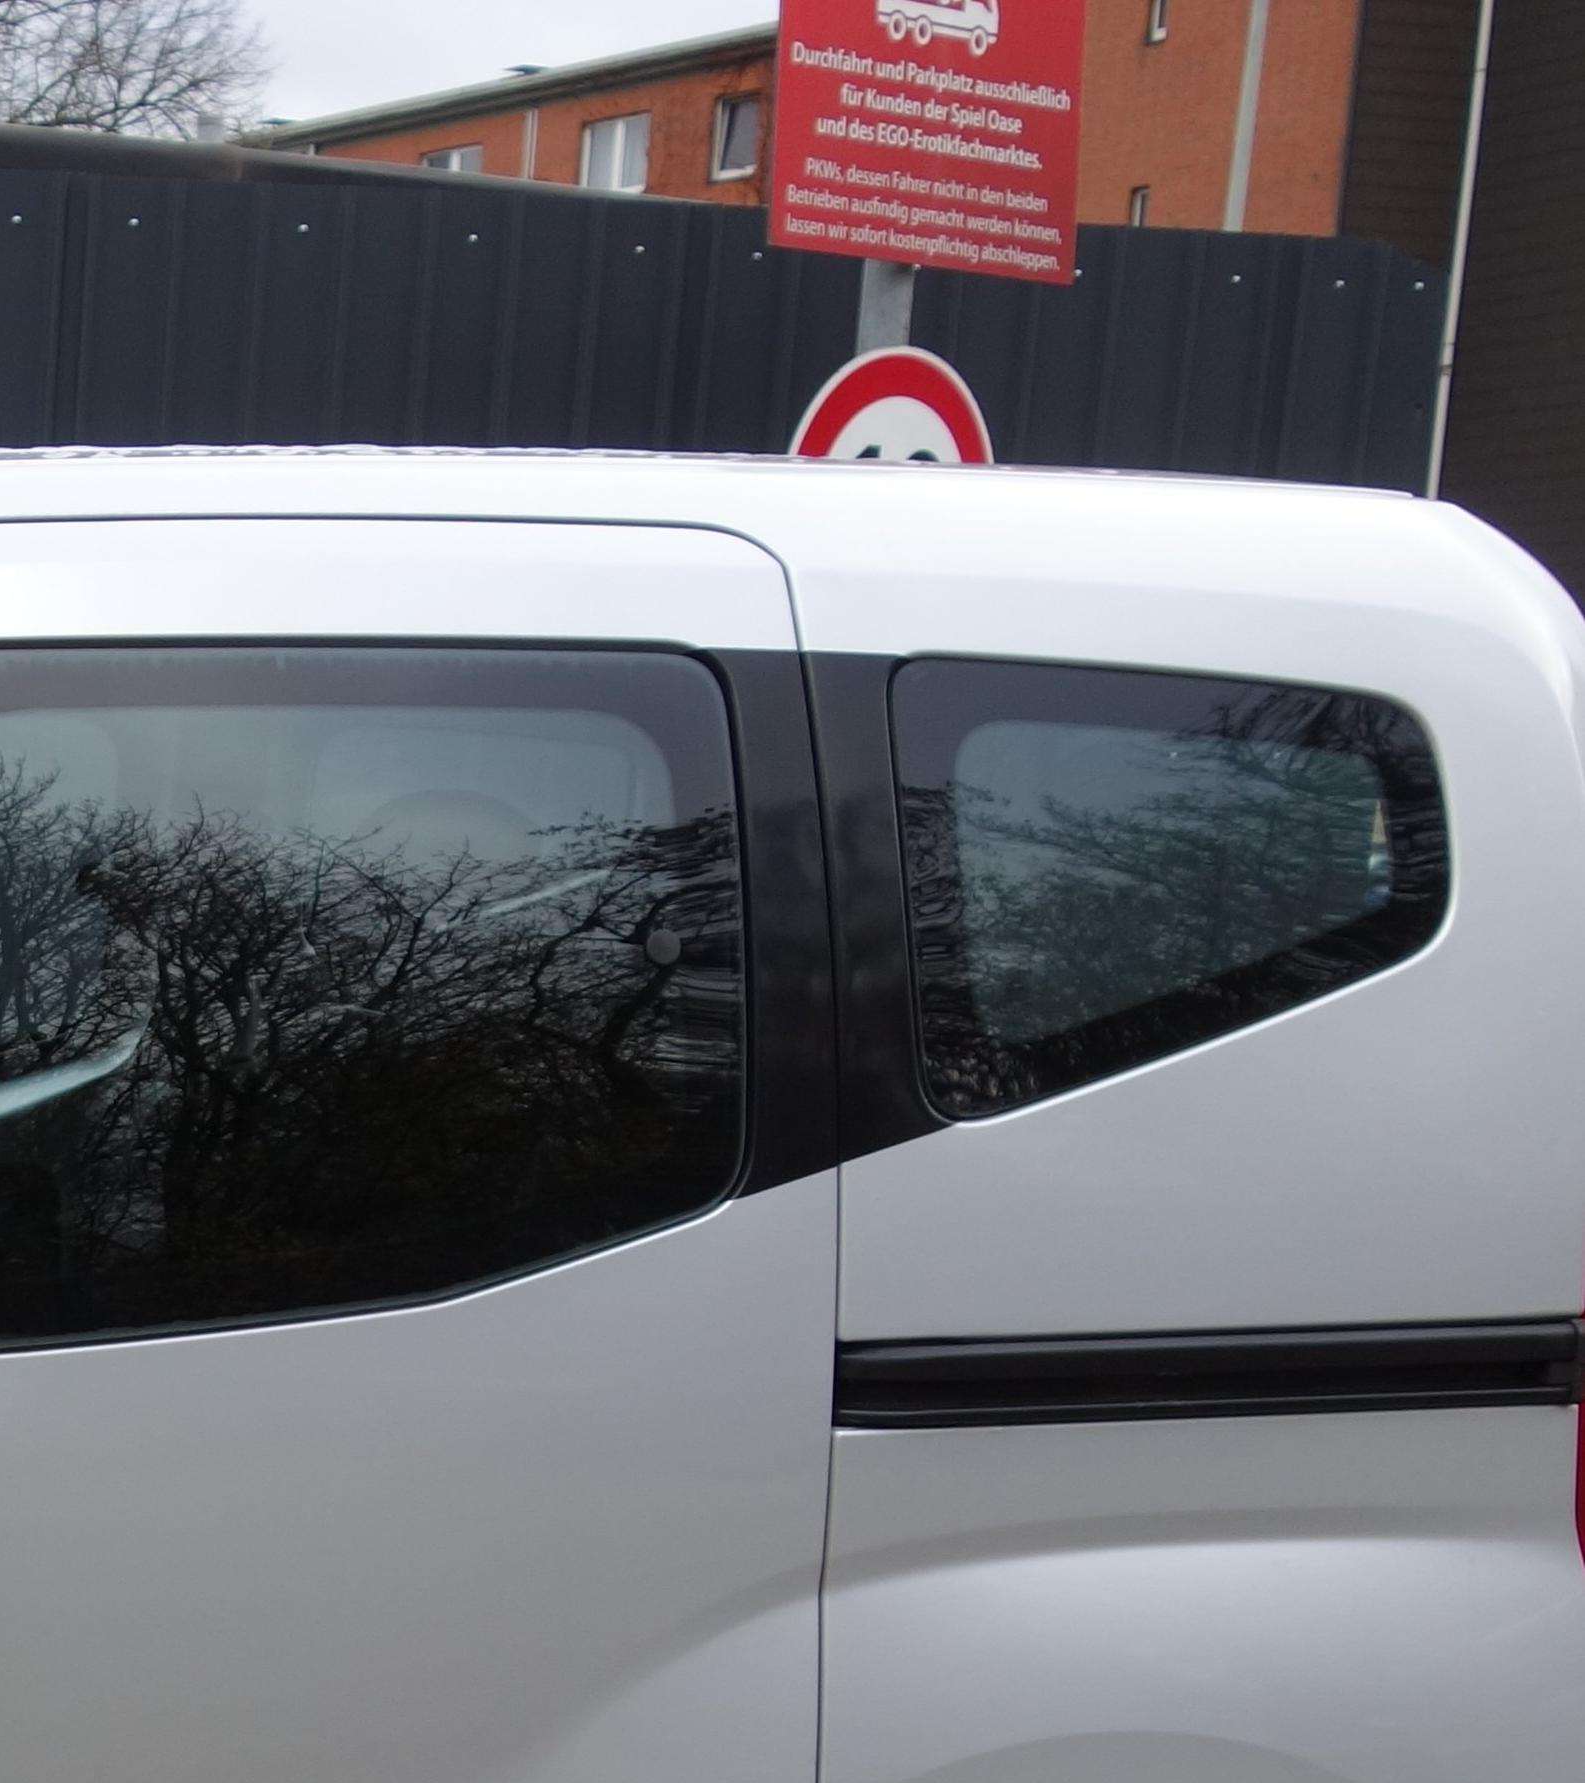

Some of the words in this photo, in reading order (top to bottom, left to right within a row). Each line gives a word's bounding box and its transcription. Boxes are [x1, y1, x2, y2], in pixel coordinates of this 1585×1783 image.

[792, 40, 873, 75] Durchfahrt
[876, 60, 906, 81] und
[907, 61, 973, 93] Parkplatz
[974, 79, 1071, 111] ausschließlich
[841, 82, 863, 107] für
[866, 87, 922, 116] Kunden
[924, 97, 949, 121] der
[950, 102, 987, 129] Spiel
[988, 109, 1023, 134] Oase
[816, 115, 847, 137] und
[848, 117, 875, 141] des
[877, 121, 1043, 170] EGO-Erotikfachmarktes.
[806, 157, 844, 183] PKWs,
[846, 164, 891, 188] dessen
[892, 171, 931, 194] Fahrer
[933, 179, 966, 199] nicht
[966, 182, 979, 201] in
[979, 184, 1005, 205] den
[1005, 189, 1049, 212] beiden
[786, 212, 825, 236] lassen
[828, 221, 849, 241] wir
[849, 224, 887, 246] sofort
[888, 227, 979, 264] kostenpflichtig
[980, 242, 1060, 272] abschleppen.
[787, 184, 850, 211] Betrieben
[851, 197, 909, 224] ausfindig
[910, 206, 965, 228] gemacht
[967, 214, 1012, 234] werden
[1013, 217, 1062, 245] können,
